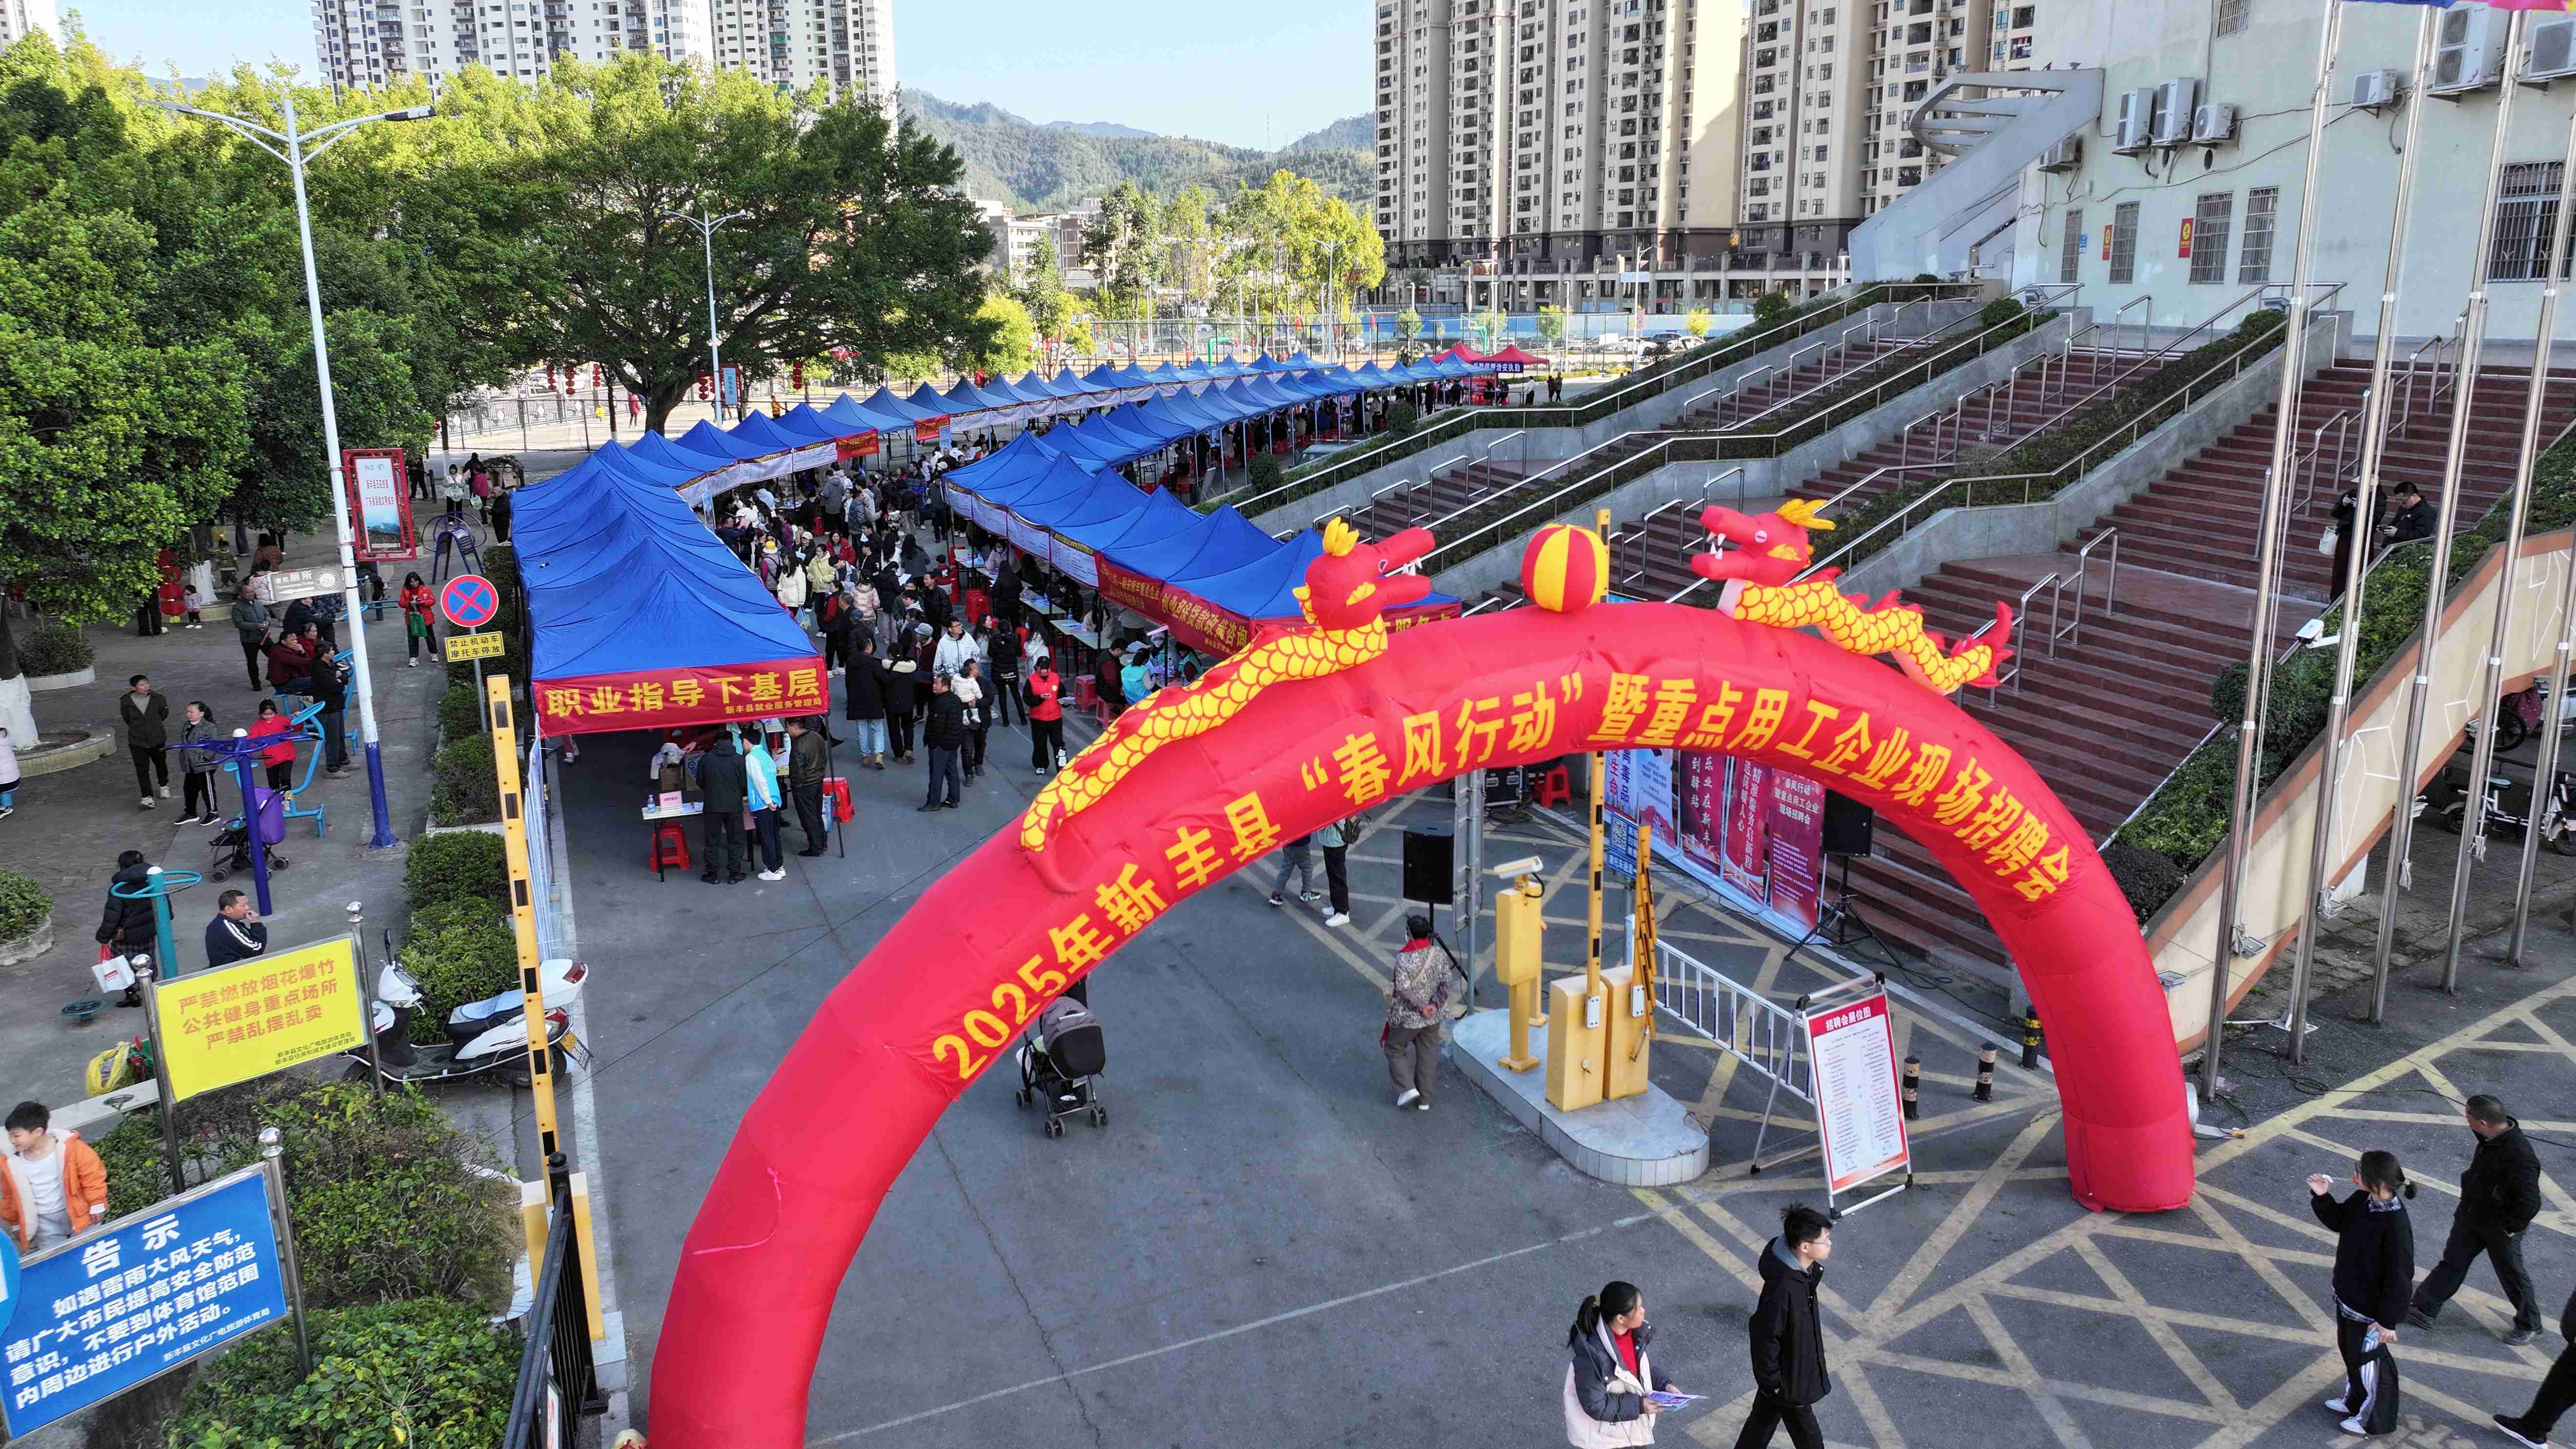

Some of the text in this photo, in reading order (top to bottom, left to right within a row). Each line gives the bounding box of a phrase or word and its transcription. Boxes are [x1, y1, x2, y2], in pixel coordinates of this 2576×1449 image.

[275, 570, 313, 584] 便民厕所
[450, 635, 499, 648] 禁止机动车
[1162, 593, 1248, 647] 创业担保贷款政策咨询
[451, 645, 500, 658] 摩托车停放
[545, 667, 820, 718] 职业指导下基层
[725, 699, 822, 714] 新丰县就业服务管理局
[1745, 766, 1762, 870] 精准服务启新程
[1774, 787, 1819, 813] 暨重点用工企业
[1779, 803, 1811, 825] 现场招聘会
[179, 958, 335, 1015] 严禁燃放烟花爆竹
[182, 979, 338, 1036] 公共健身重点场所
[206, 1006, 322, 1051] 严禁乱摆乱卖
[1826, 1006, 1872, 1031] 招聘会展位图
[81, 1213, 180, 1277] 告示
[52, 1228, 242, 1319] 如遇雷雨大风天气，
[5, 1242, 256, 1364] 请广大市民提高安全防范
[10, 1263, 260, 1387] 意识，不要到体育馆范围
[15, 1304, 231, 1409] 内周边进行户外活动。
